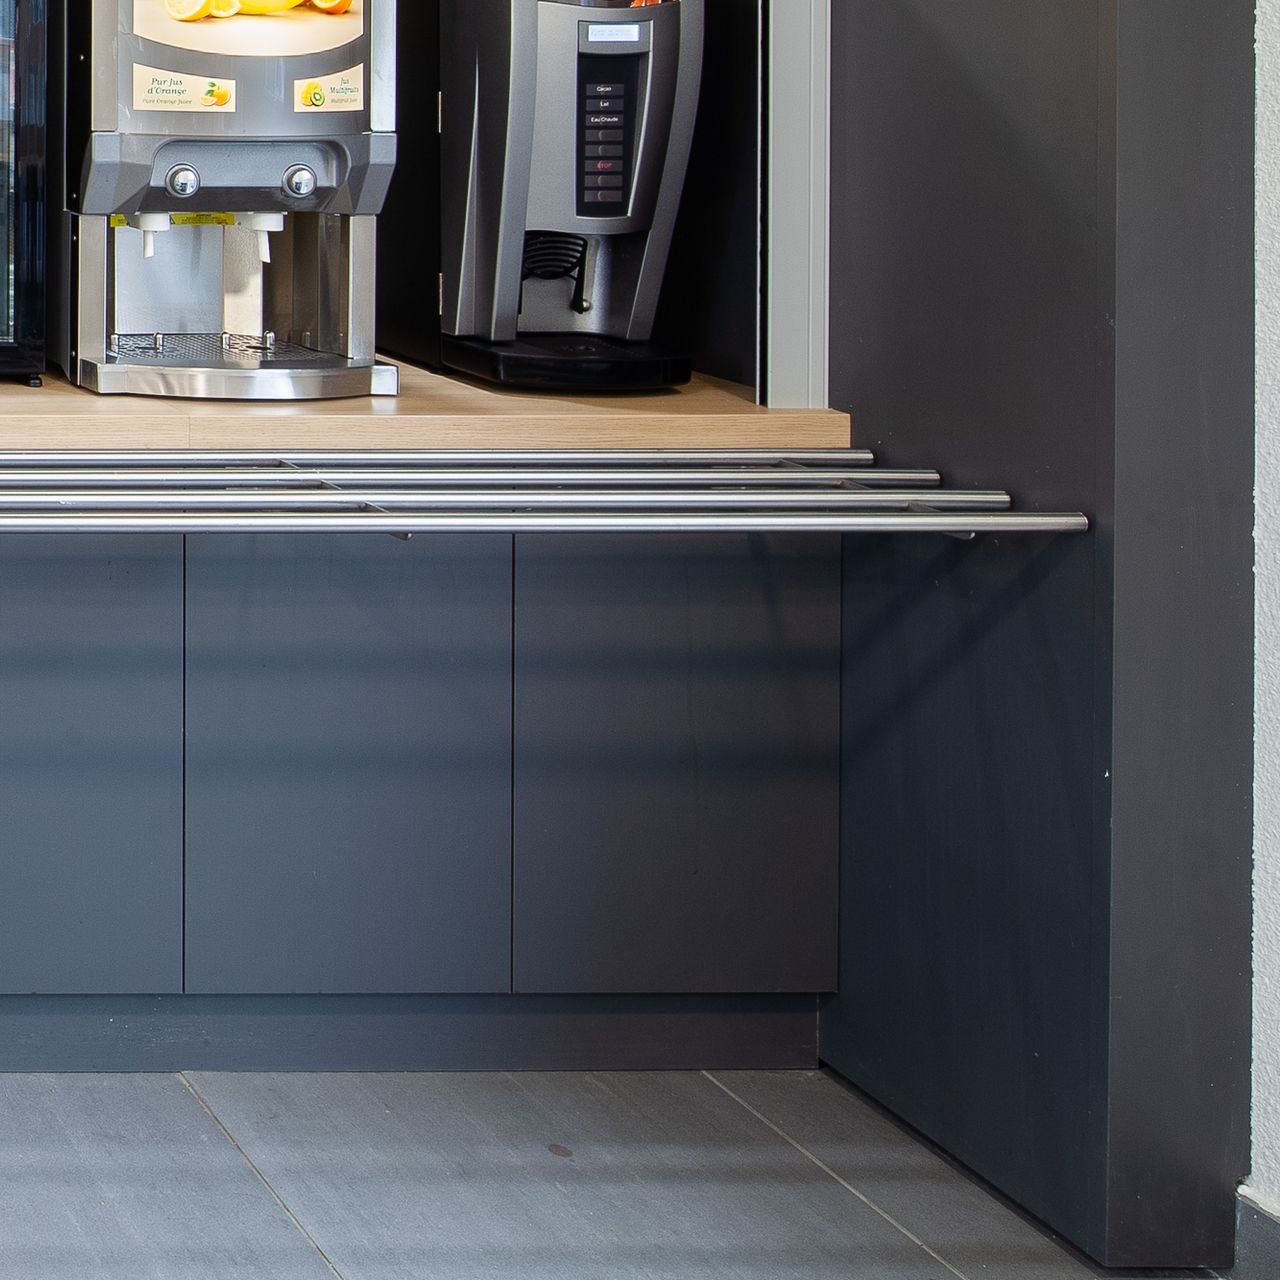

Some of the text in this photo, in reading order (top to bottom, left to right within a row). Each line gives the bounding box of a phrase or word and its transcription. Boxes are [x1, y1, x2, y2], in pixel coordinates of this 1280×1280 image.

[151, 77, 183, 87] Pur Jus
[147, 86, 188, 96] d'Orange
